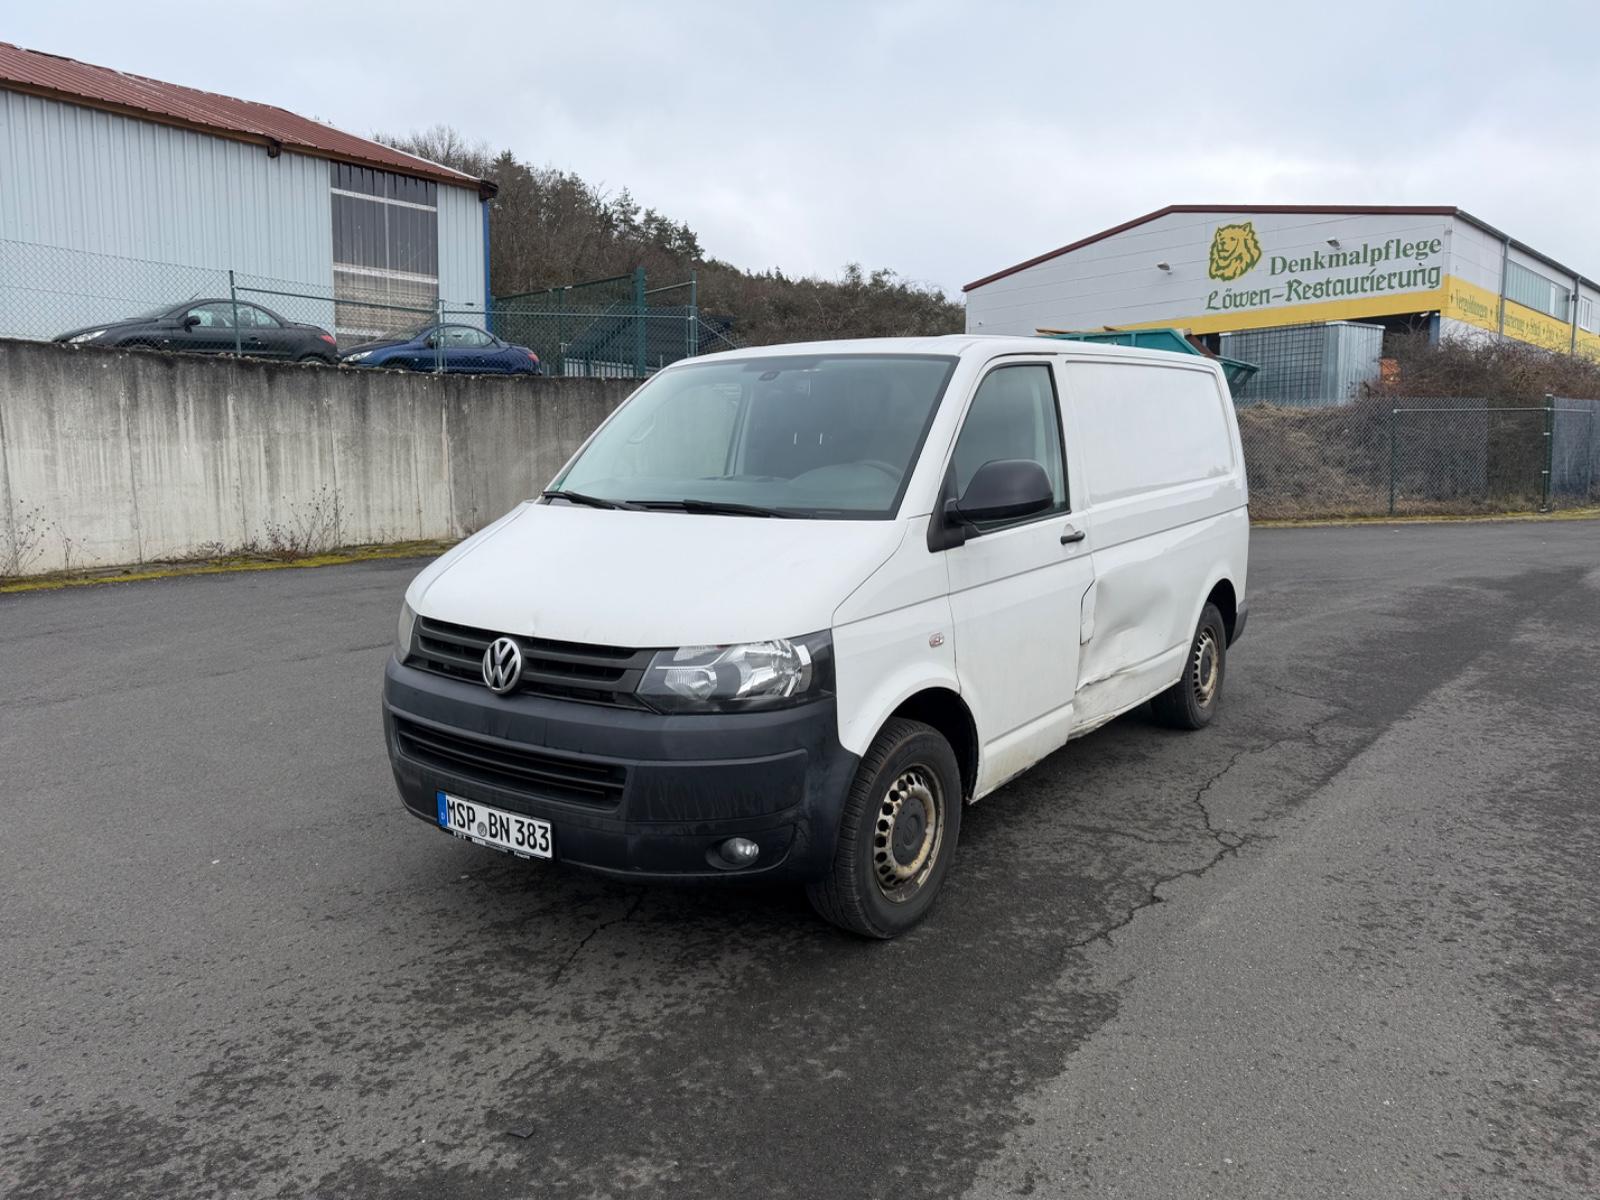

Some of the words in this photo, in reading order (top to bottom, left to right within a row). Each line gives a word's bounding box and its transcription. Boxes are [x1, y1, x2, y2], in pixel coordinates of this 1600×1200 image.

[1269, 238, 1442, 276] Denkmalpflege
[1205, 266, 1441, 310] Löwen-Restaurierung
[447, 799, 476, 831] MSP
[488, 812, 511, 843] BN
[514, 819, 550, 852] 383
